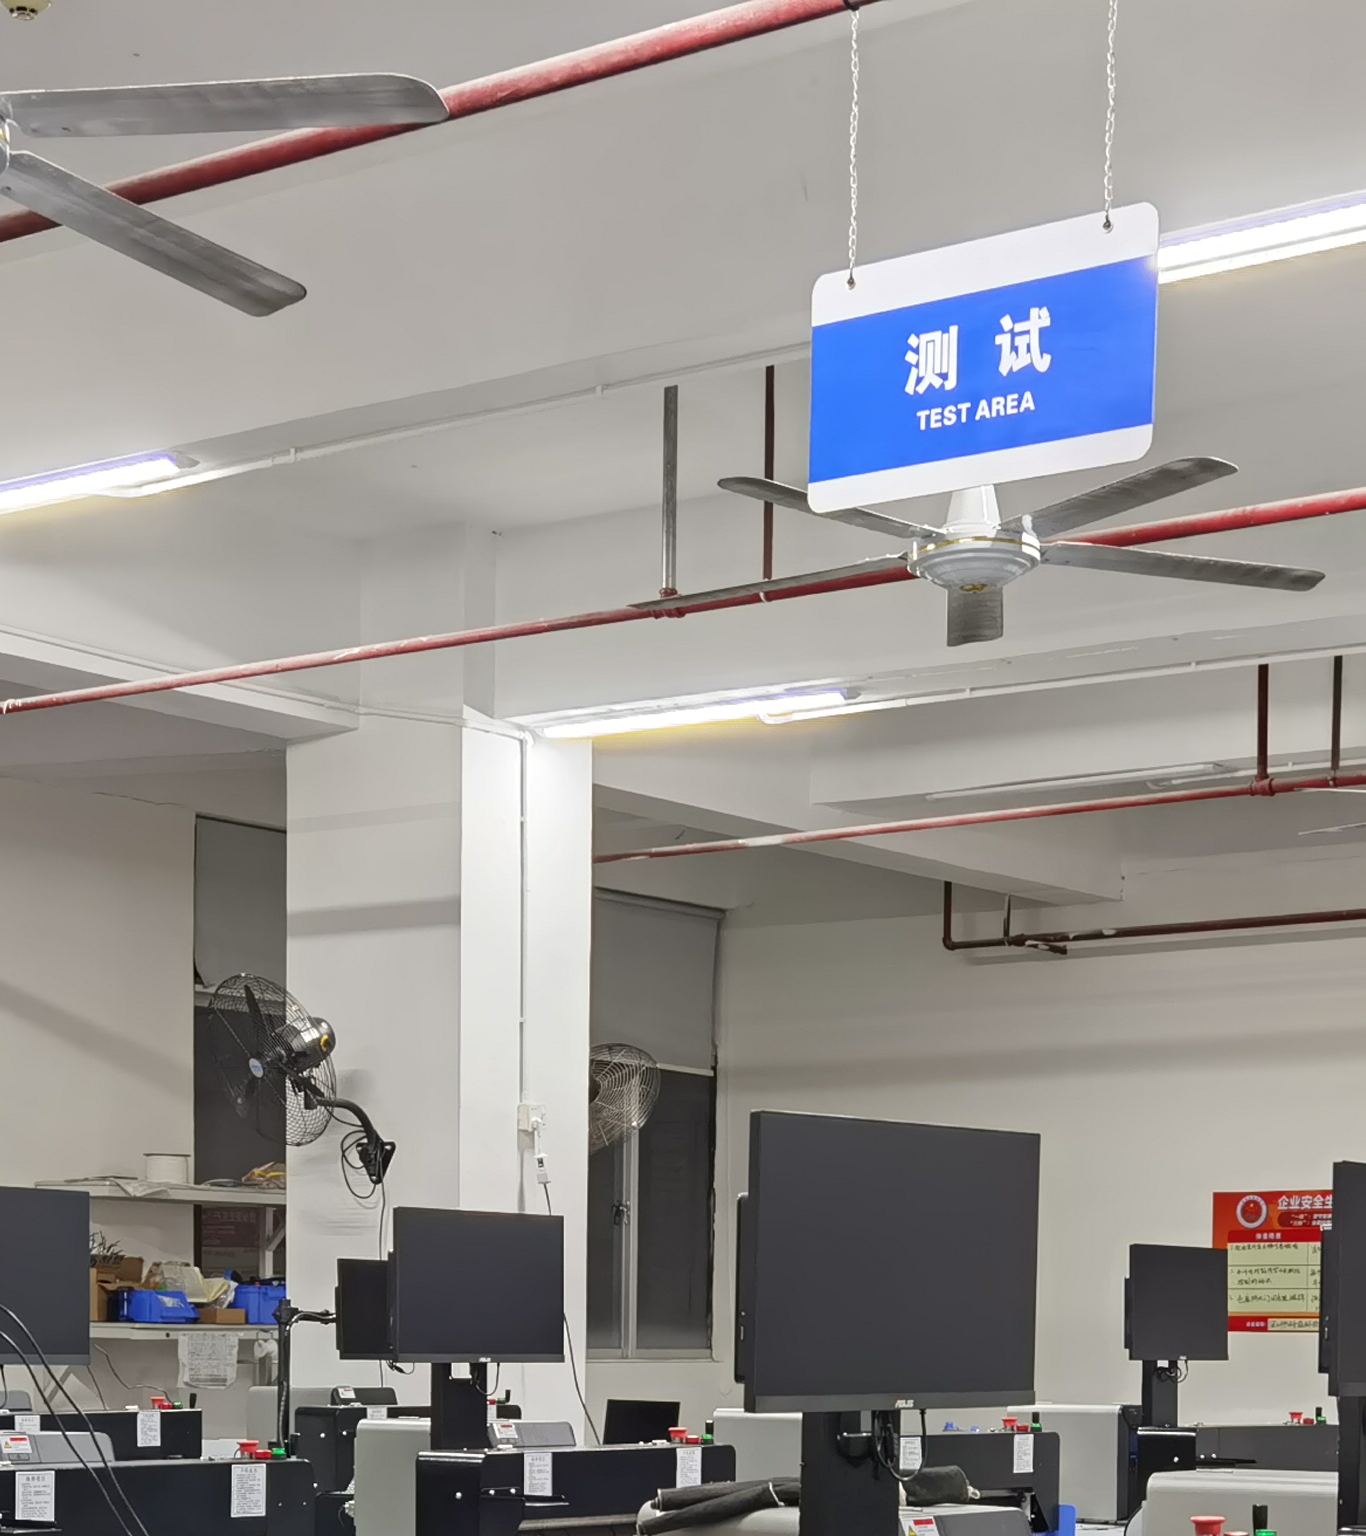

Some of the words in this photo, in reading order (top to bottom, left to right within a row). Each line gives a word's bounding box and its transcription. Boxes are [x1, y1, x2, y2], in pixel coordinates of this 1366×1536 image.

[904, 306, 1051, 396] 测试
[916, 402, 971, 431] TEST
[975, 390, 1035, 421] AREA
